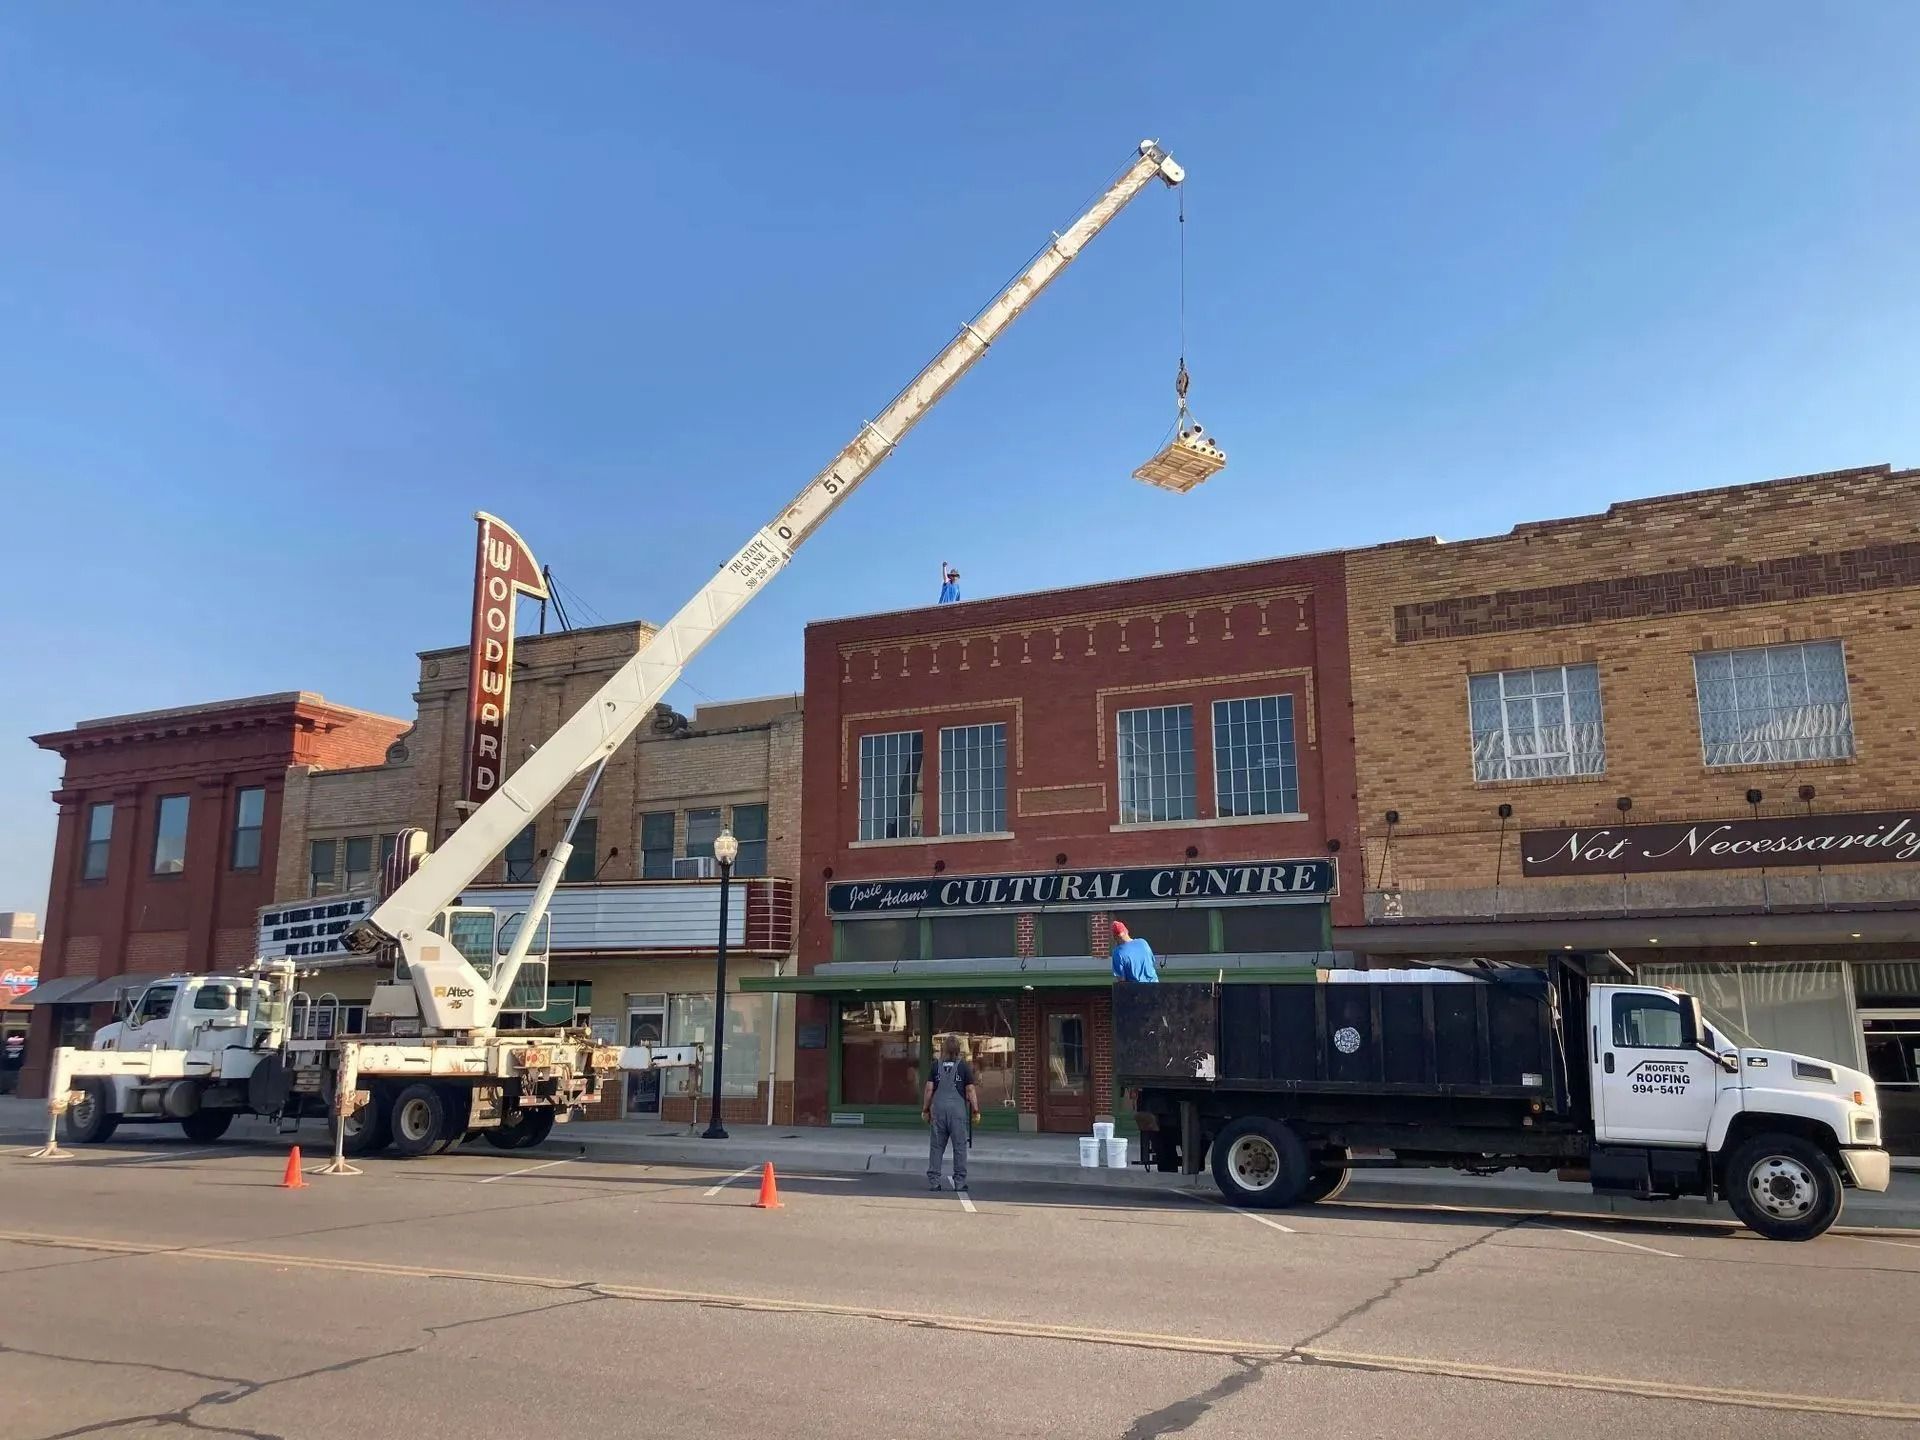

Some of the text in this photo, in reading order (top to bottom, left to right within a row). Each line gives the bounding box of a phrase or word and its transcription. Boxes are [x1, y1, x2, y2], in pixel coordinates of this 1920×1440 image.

[823, 472, 845, 494] 51
[740, 552, 766, 577] CRANE
[476, 537, 512, 791] WOODWARD
[1526, 818, 1920, 863] Not Necessarily
[850, 864, 1317, 909] Josie Adams CULTURAL CENTRE
[446, 986, 474, 997] Altec
[1636, 1073, 1691, 1084] ROOFING
[1645, 1064, 1685, 1073] MOORE'S
[1632, 1084, 1686, 1095] 994-5417
